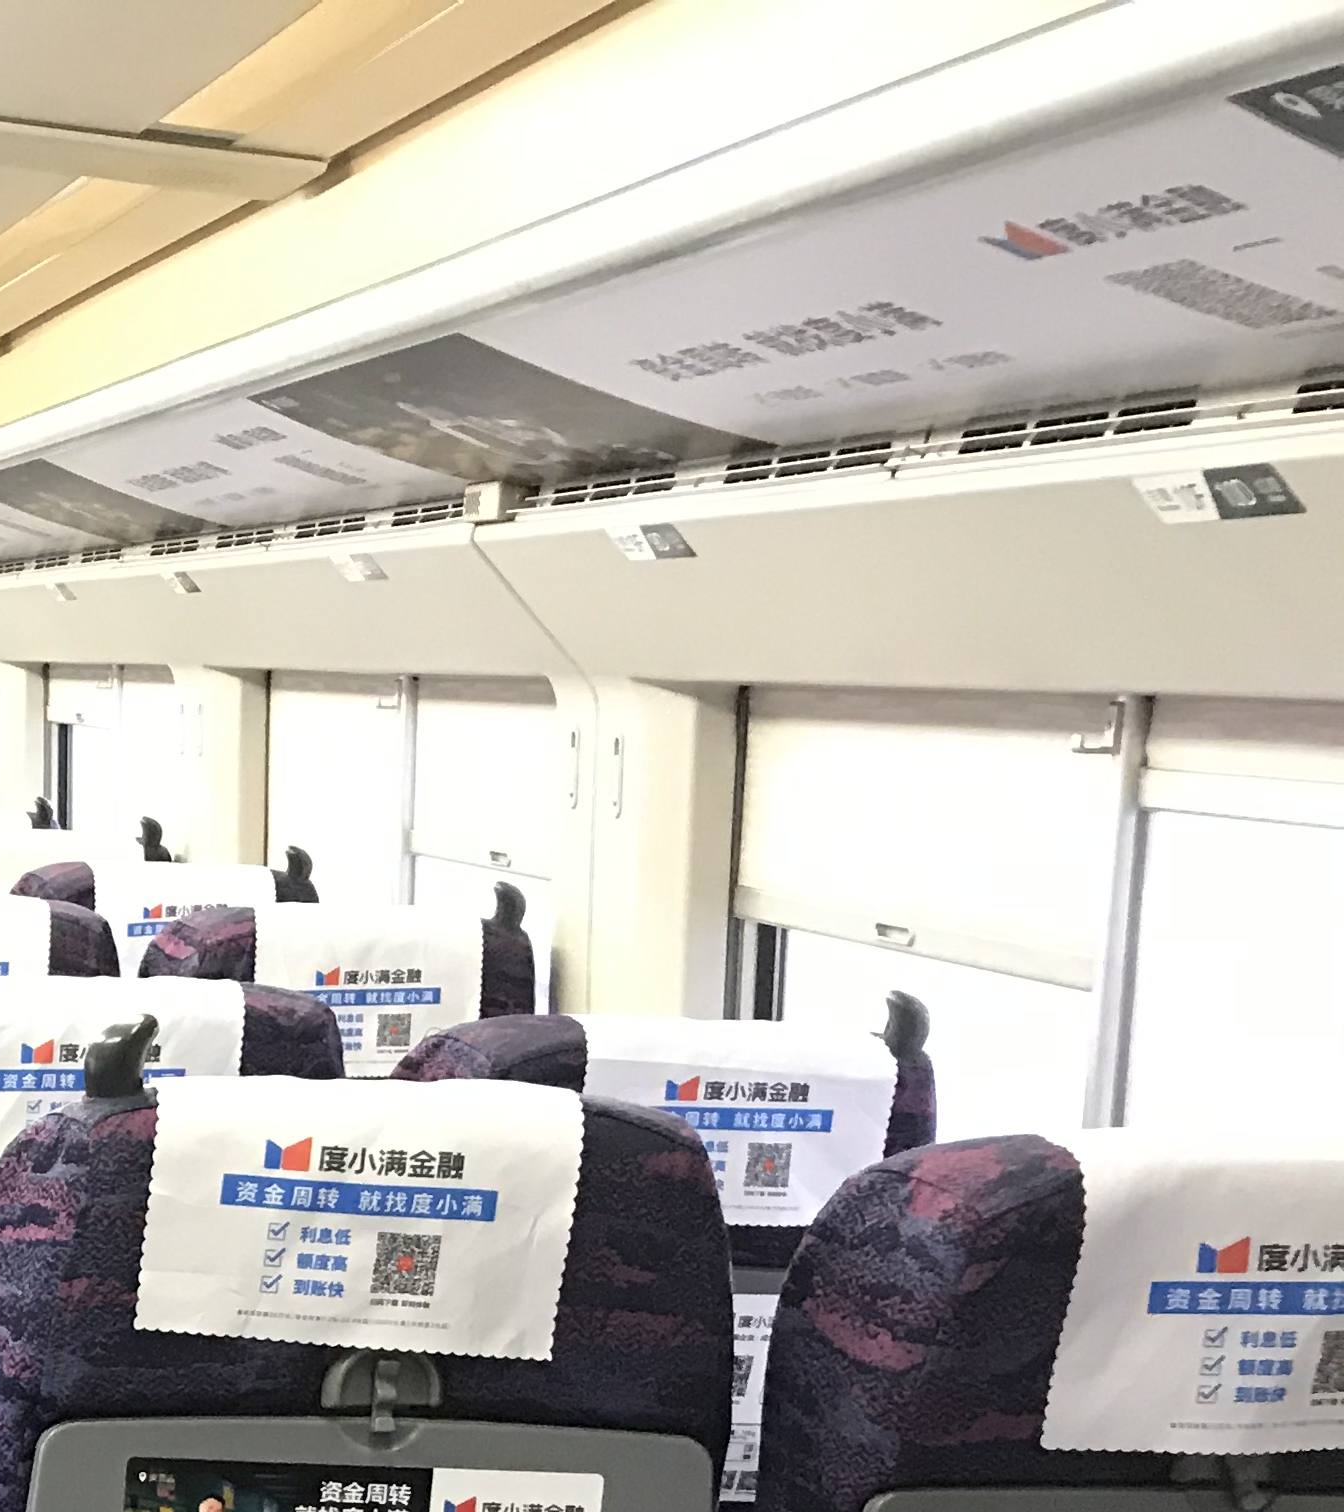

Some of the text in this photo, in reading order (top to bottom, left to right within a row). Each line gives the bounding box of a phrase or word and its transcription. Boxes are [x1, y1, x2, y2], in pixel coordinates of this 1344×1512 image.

[343, 968, 422, 985] 度小满金融
[2, 1072, 76, 1089] 资金周转
[704, 1081, 810, 1103] 度小满金融
[733, 1111, 822, 1129] 就找度小满
[319, 1145, 466, 1180] 度小满金融
[236, 1181, 483, 1217] 资金周转 就找度小满
[300, 1226, 351, 1246] 利息低
[296, 1253, 348, 1272] 额度高
[292, 1279, 345, 1298] 到账快
[1165, 1287, 1283, 1311] 资金周转
[320, 1481, 412, 1506] 资金周转
